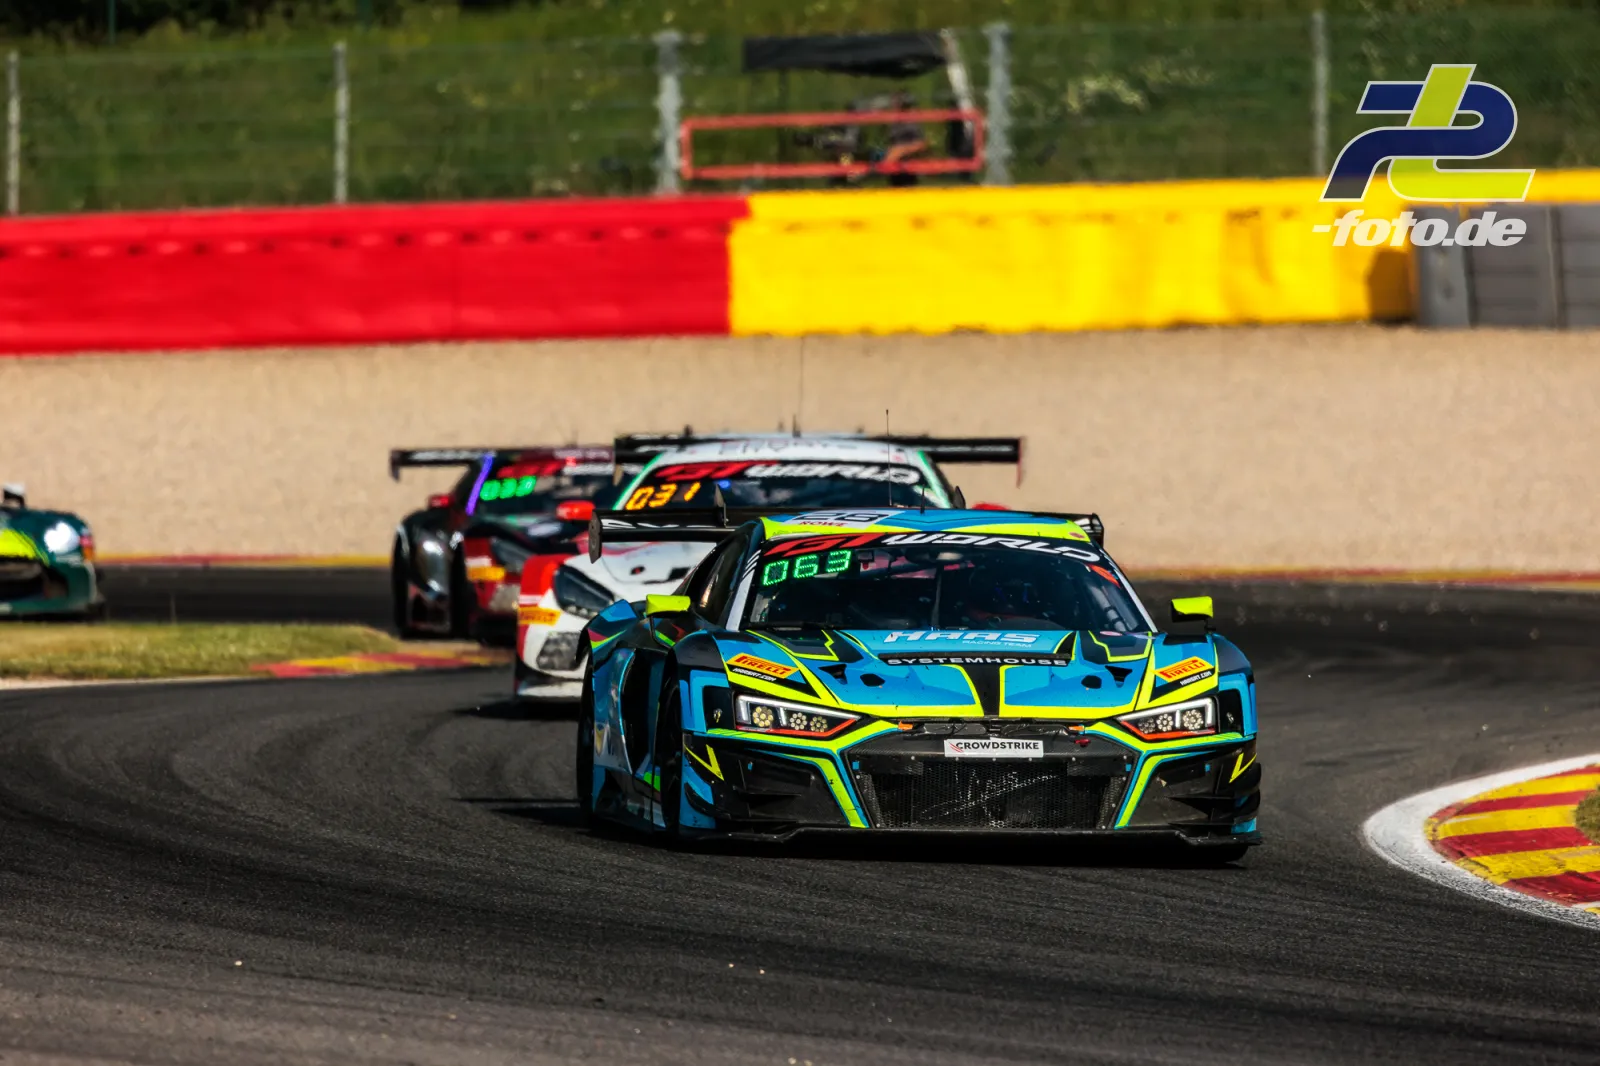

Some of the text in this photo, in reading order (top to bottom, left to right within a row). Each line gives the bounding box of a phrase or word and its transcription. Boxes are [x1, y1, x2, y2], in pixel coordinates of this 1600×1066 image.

[744, 463, 921, 485] WORLD
[625, 481, 701, 511] 031
[799, 520, 848, 528] ROWE
[763, 532, 1101, 563] GT WORLD
[762, 549, 852, 587] 063
[883, 631, 1041, 644] HAAS
[962, 639, 1002, 647] RACING
[734, 655, 791, 675] PIRELLI
[887, 656, 1068, 667] SYSTEMHOUSE
[1158, 659, 1206, 679] PIRELLI
[955, 741, 1040, 750] CROWDSTRIKE
